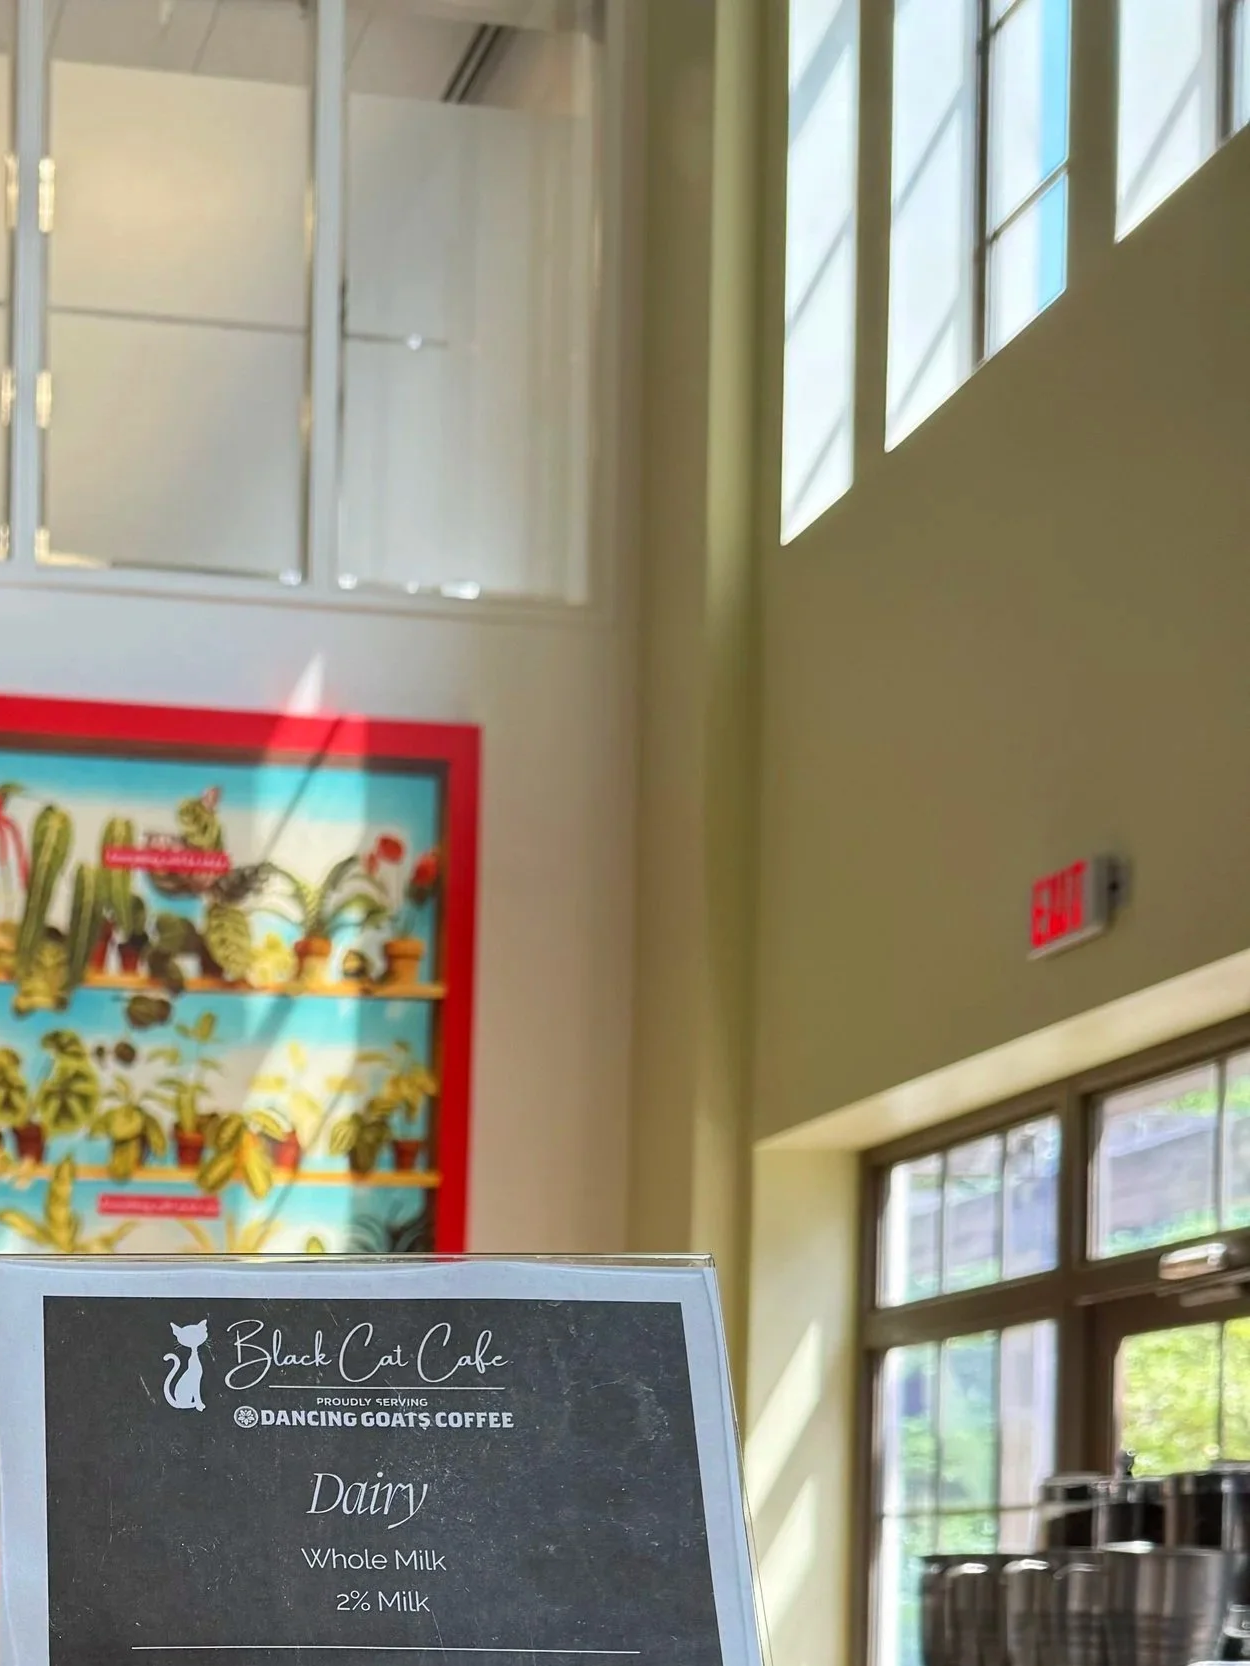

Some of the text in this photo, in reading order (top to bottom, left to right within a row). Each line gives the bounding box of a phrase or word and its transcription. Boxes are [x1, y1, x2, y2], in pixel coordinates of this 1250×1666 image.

[225, 1319, 509, 1389] Black Cat Cafe
[314, 1395, 430, 1409] PROUDLY SERVING
[260, 1408, 514, 1429] DANCING GOATS COFFEE
[306, 1471, 428, 1530] Dairy
[300, 1547, 447, 1571] Whole Milk
[336, 1590, 431, 1612] 2% Milk
